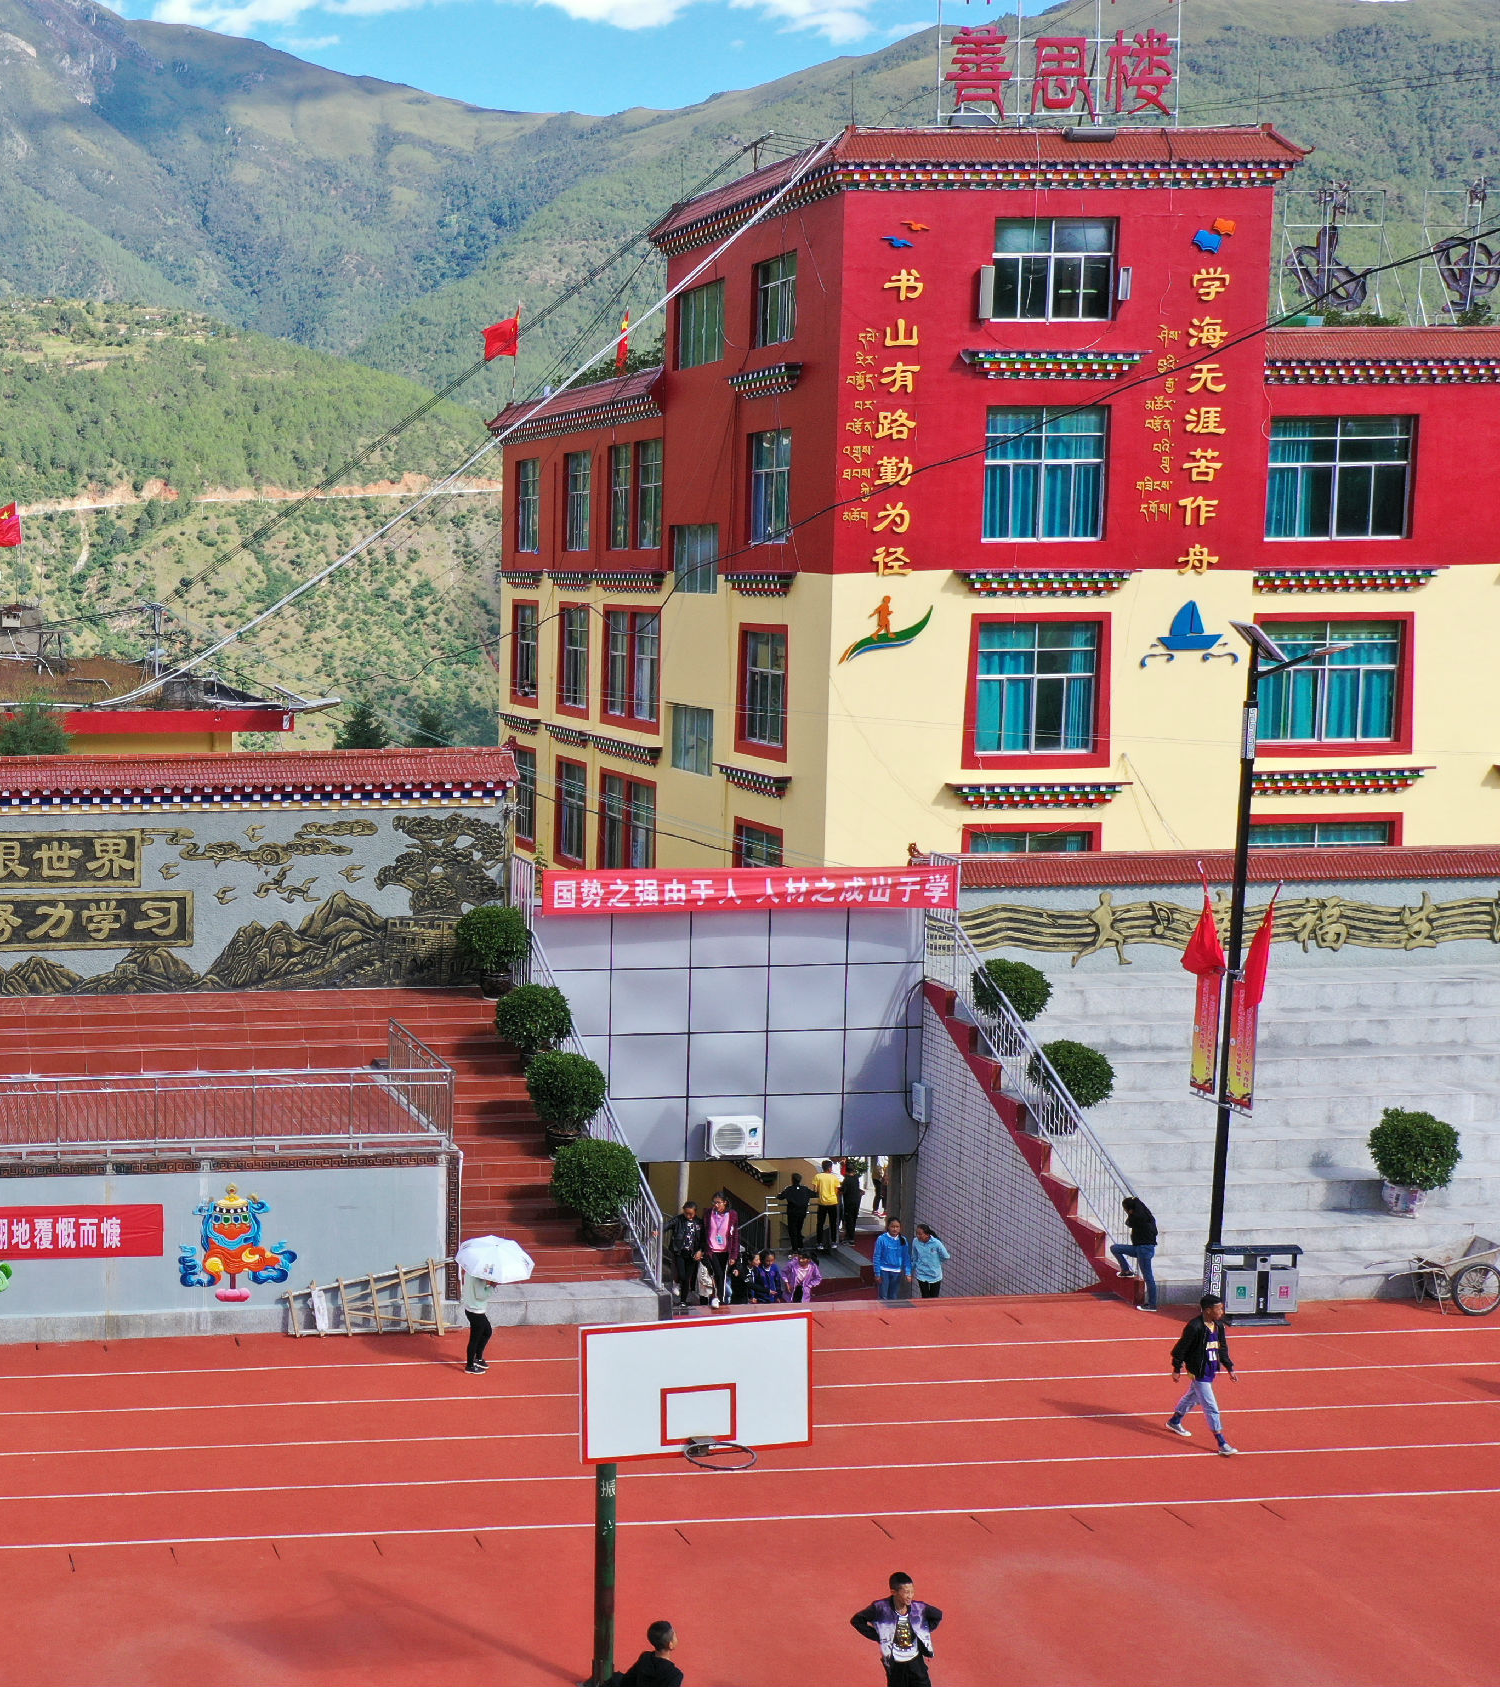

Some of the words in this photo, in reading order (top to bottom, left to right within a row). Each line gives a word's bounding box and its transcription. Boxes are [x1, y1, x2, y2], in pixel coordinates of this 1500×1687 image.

[944, 26, 1174, 123] 善思楼
[872, 268, 924, 577] 书山有路勤为径
[1177, 266, 1231, 575] 学海无涯苦作舟
[553, 877, 743, 909] 国势之强由于人
[755, 873, 950, 906] 人材之成出于学
